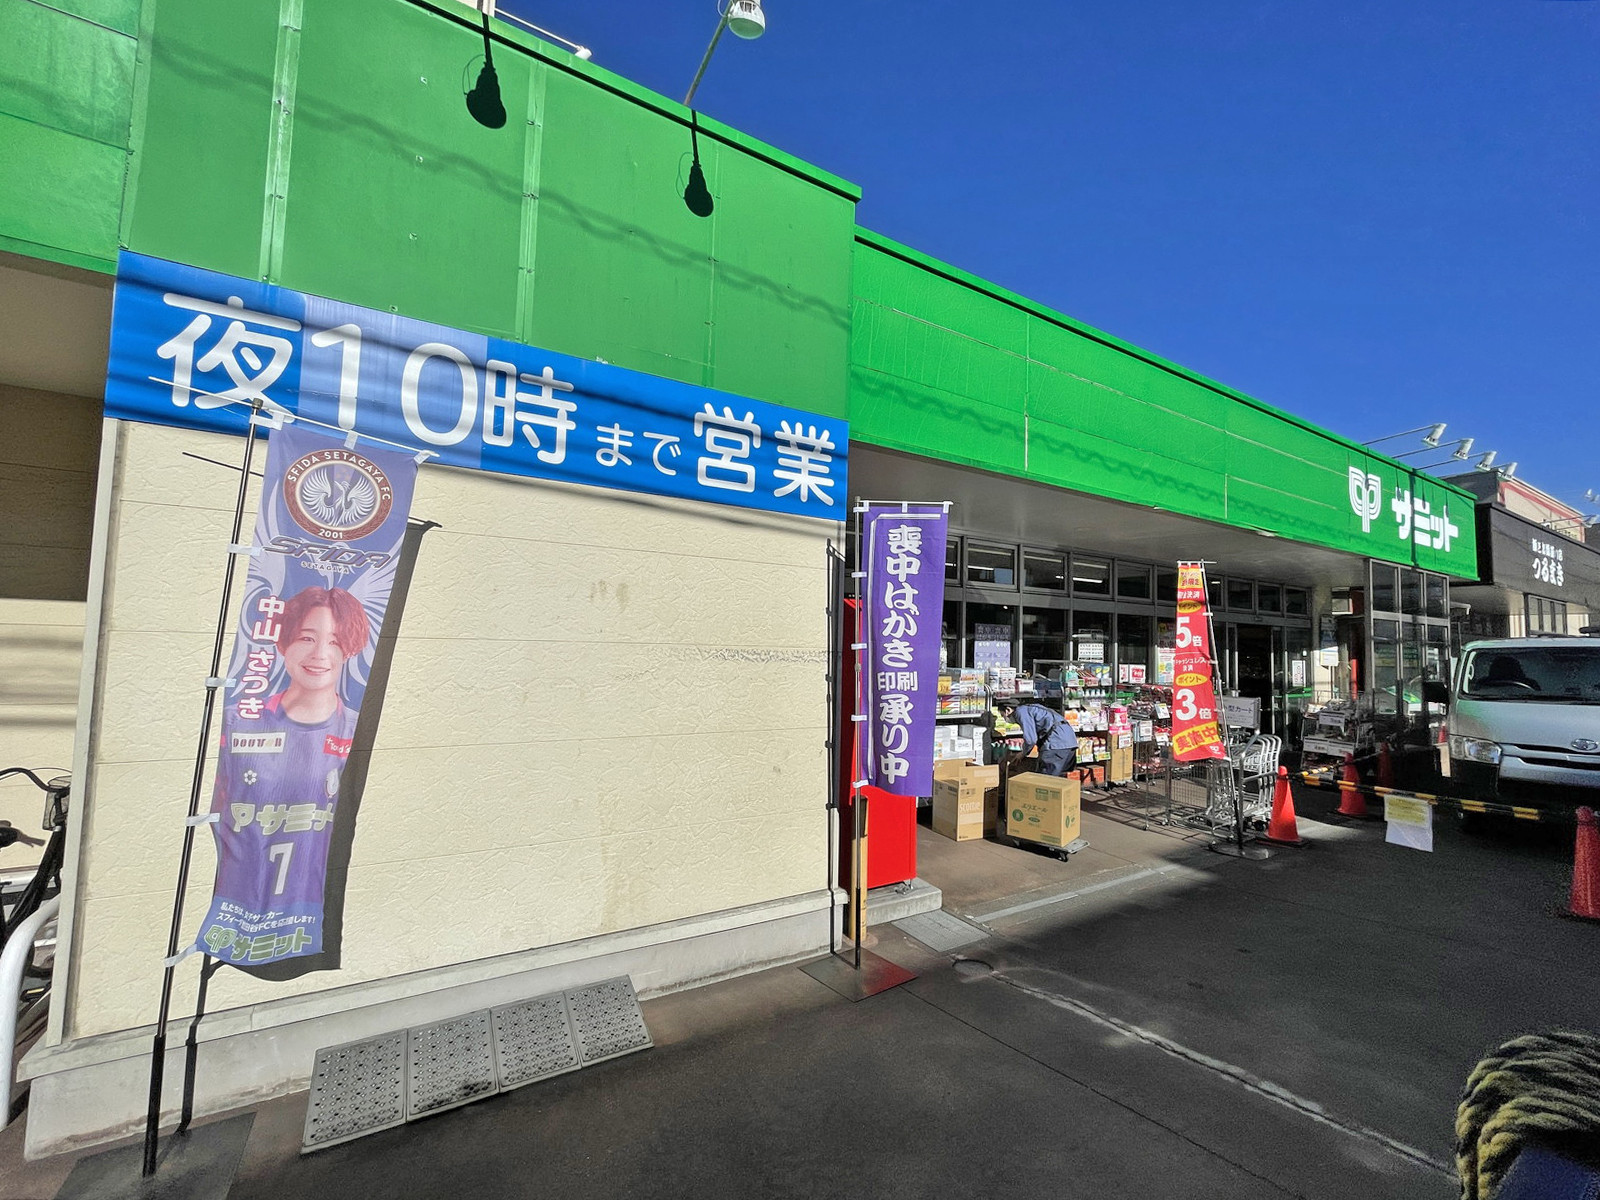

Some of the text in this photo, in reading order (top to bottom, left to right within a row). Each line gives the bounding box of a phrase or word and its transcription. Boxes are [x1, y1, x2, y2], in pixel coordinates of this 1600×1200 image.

[157, 296, 834, 506] 夜10時まで営業
[287, 451, 392, 501] SFIDA SETAGAYA FC
[318, 528, 344, 540] 2001
[1392, 486, 1459, 553] サミット
[262, 534, 392, 569] SFIDA
[301, 561, 350, 575] SETAGAYA
[239, 596, 285, 719] 中山さつき
[877, 524, 923, 785] 喪中はがき印刷承り中
[1175, 726, 1217, 751] 実施中
[269, 842, 294, 895] 7
[231, 927, 312, 961] サミット
